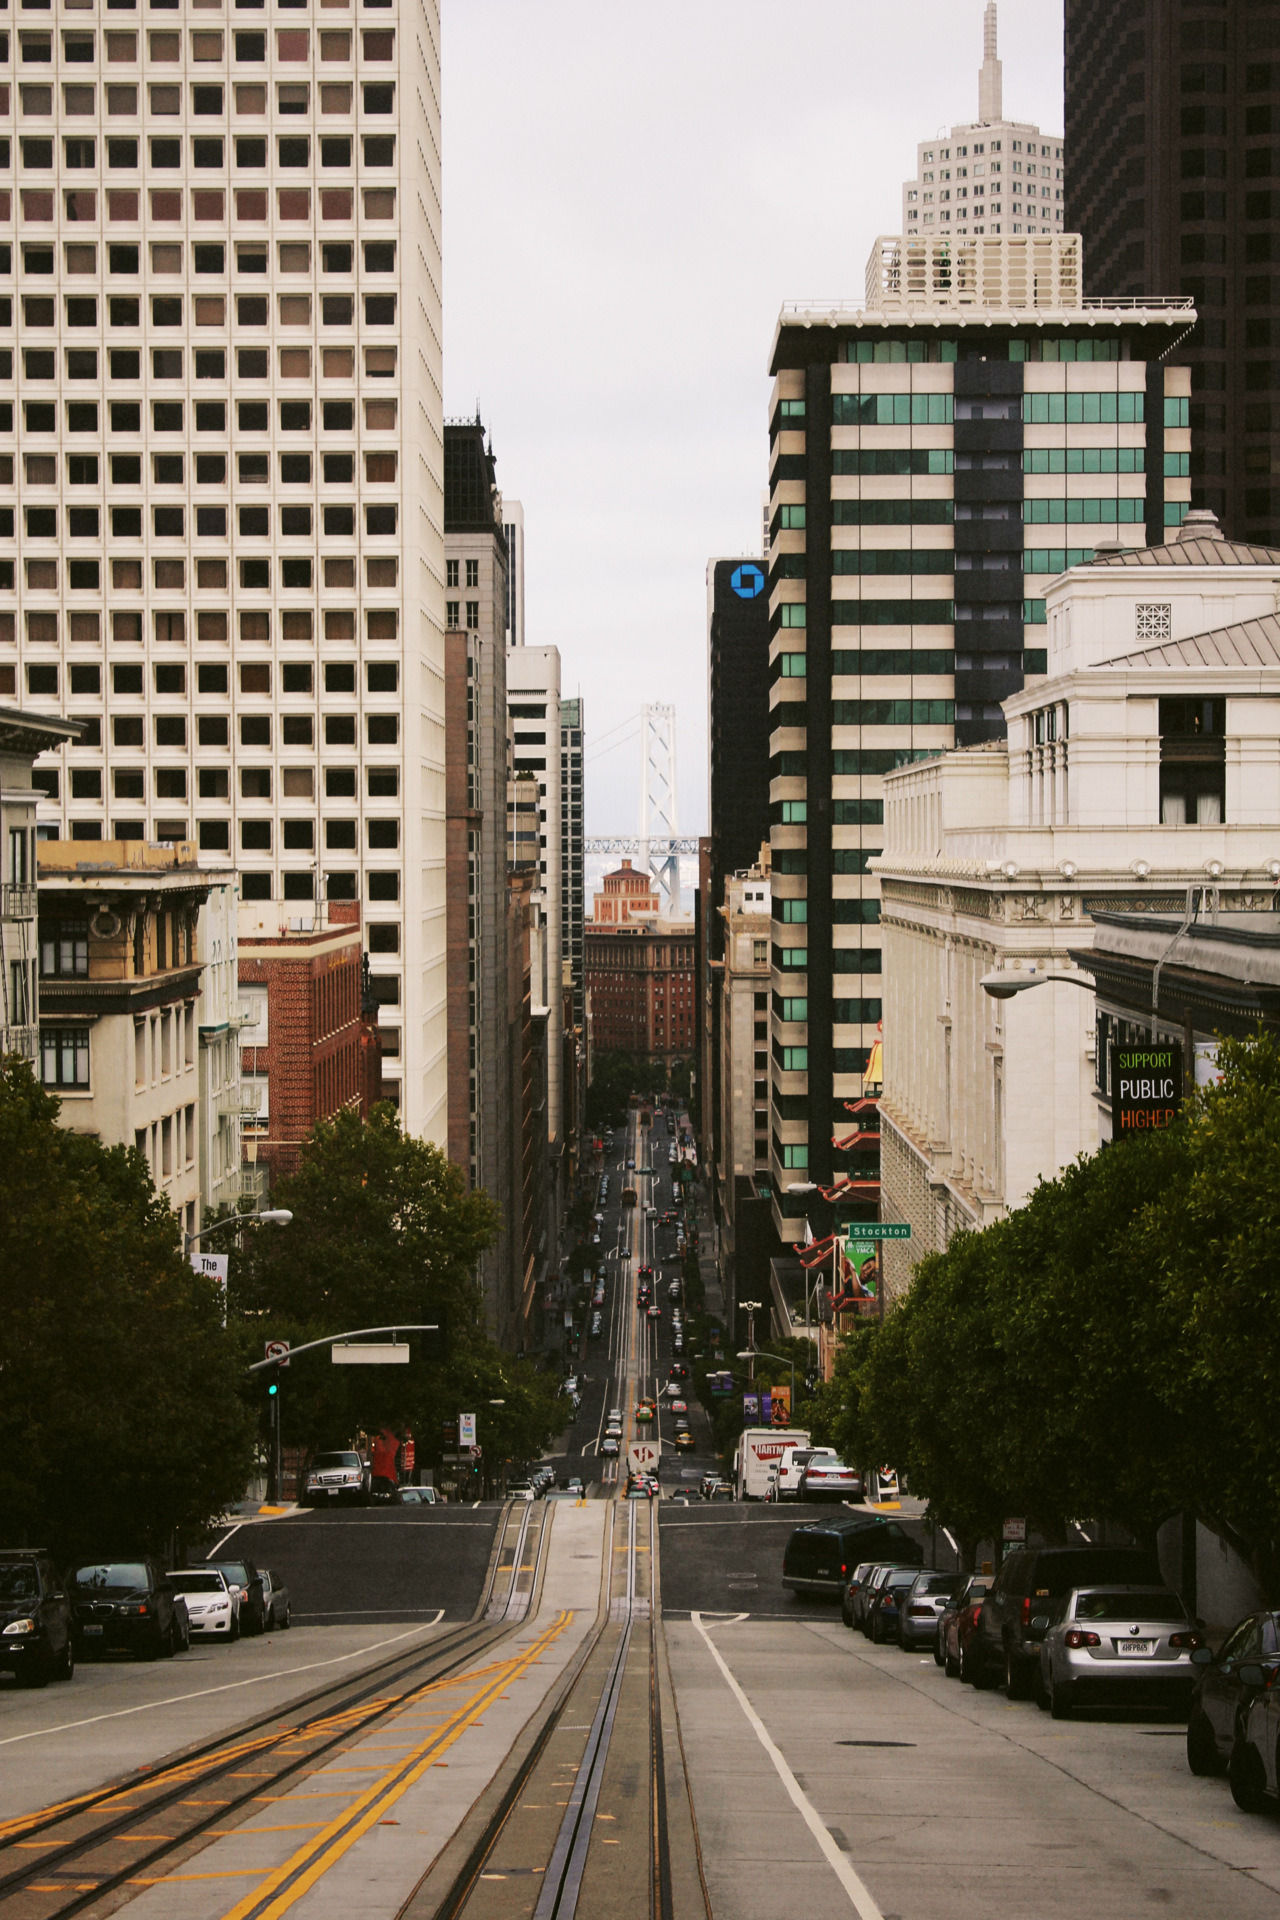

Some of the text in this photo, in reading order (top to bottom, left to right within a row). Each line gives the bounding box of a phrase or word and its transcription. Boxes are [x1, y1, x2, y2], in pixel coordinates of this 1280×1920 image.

[1119, 1052, 1173, 1069] SUPPORT
[1120, 1079, 1174, 1099] PUBLIC
[854, 1227, 907, 1236] Stockton
[201, 1258, 217, 1271] The
